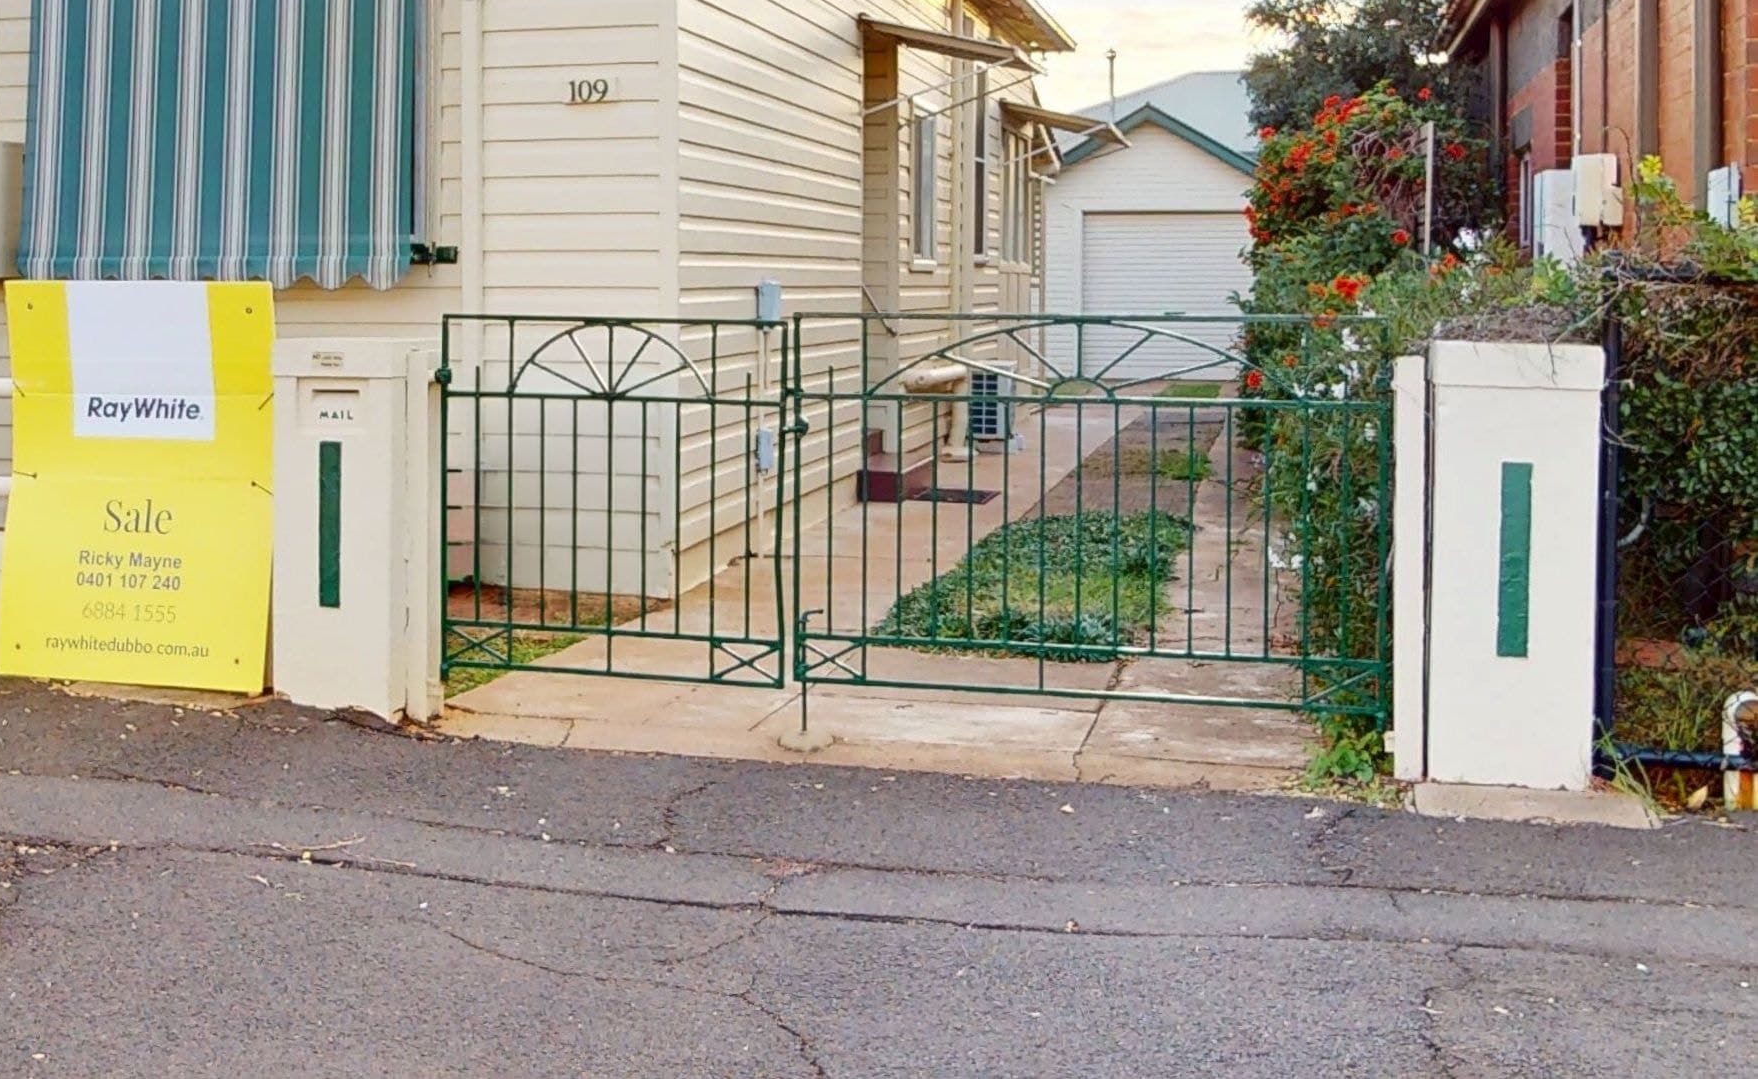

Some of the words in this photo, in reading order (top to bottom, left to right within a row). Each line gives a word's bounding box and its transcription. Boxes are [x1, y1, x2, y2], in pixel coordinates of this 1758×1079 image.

[569, 79, 608, 103] 109
[319, 410, 354, 420] MAIL
[104, 499, 173, 535] Sale
[79, 550, 123, 569] Ricky
[129, 552, 182, 571] Mayne
[76, 572, 112, 587] 0401
[121, 574, 147, 589] 107
[153, 576, 181, 591] 240
[82, 601, 126, 620] 6884
[134, 604, 177, 623] 1555
